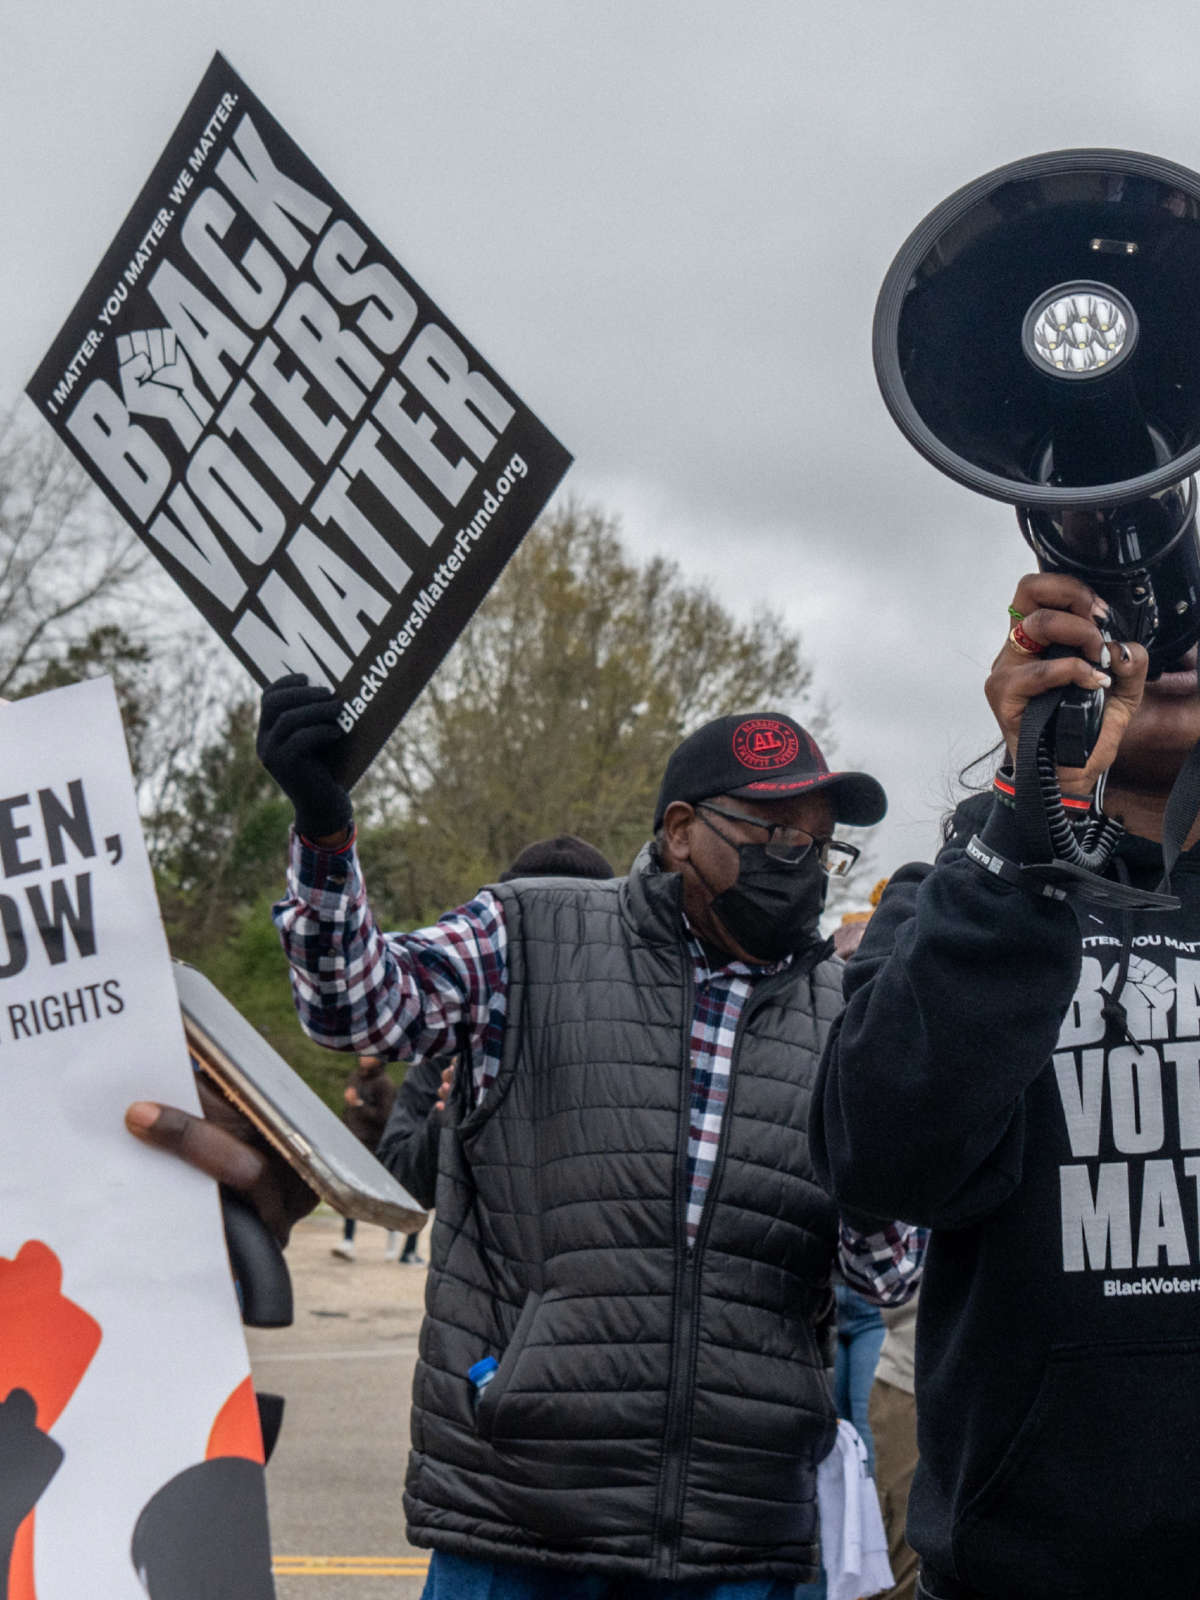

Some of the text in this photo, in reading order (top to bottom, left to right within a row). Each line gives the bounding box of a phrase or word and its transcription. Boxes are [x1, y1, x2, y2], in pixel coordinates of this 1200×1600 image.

[47, 91, 239, 415] I MATTER. YOU MATTER. WE MATTER.
[148, 219, 418, 612] VOTERS
[231, 322, 516, 695] MATTER
[337, 452, 528, 733] BlackVotersMatterFund.org
[753, 731, 782, 750] AL
[8, 979, 125, 1040] RIGHTS
